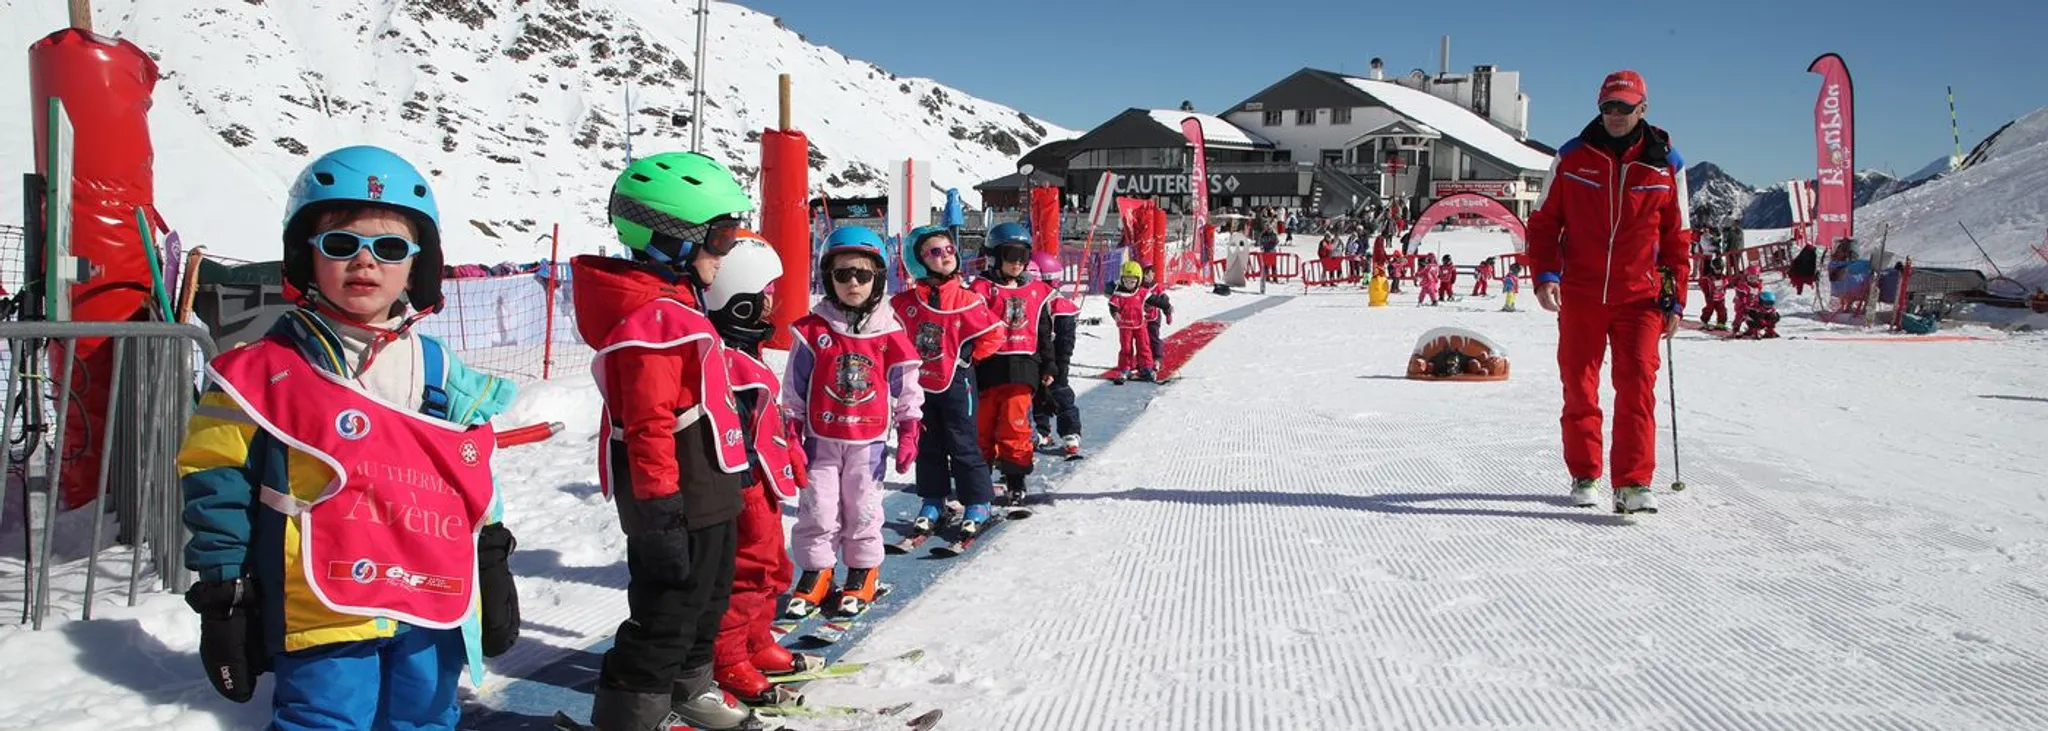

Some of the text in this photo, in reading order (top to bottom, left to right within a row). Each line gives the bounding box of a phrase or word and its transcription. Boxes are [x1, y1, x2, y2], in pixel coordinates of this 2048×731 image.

[1115, 174, 1222, 194] CAUTERS
[381, 464, 462, 497] THERMA
[342, 483, 462, 541] Avène
